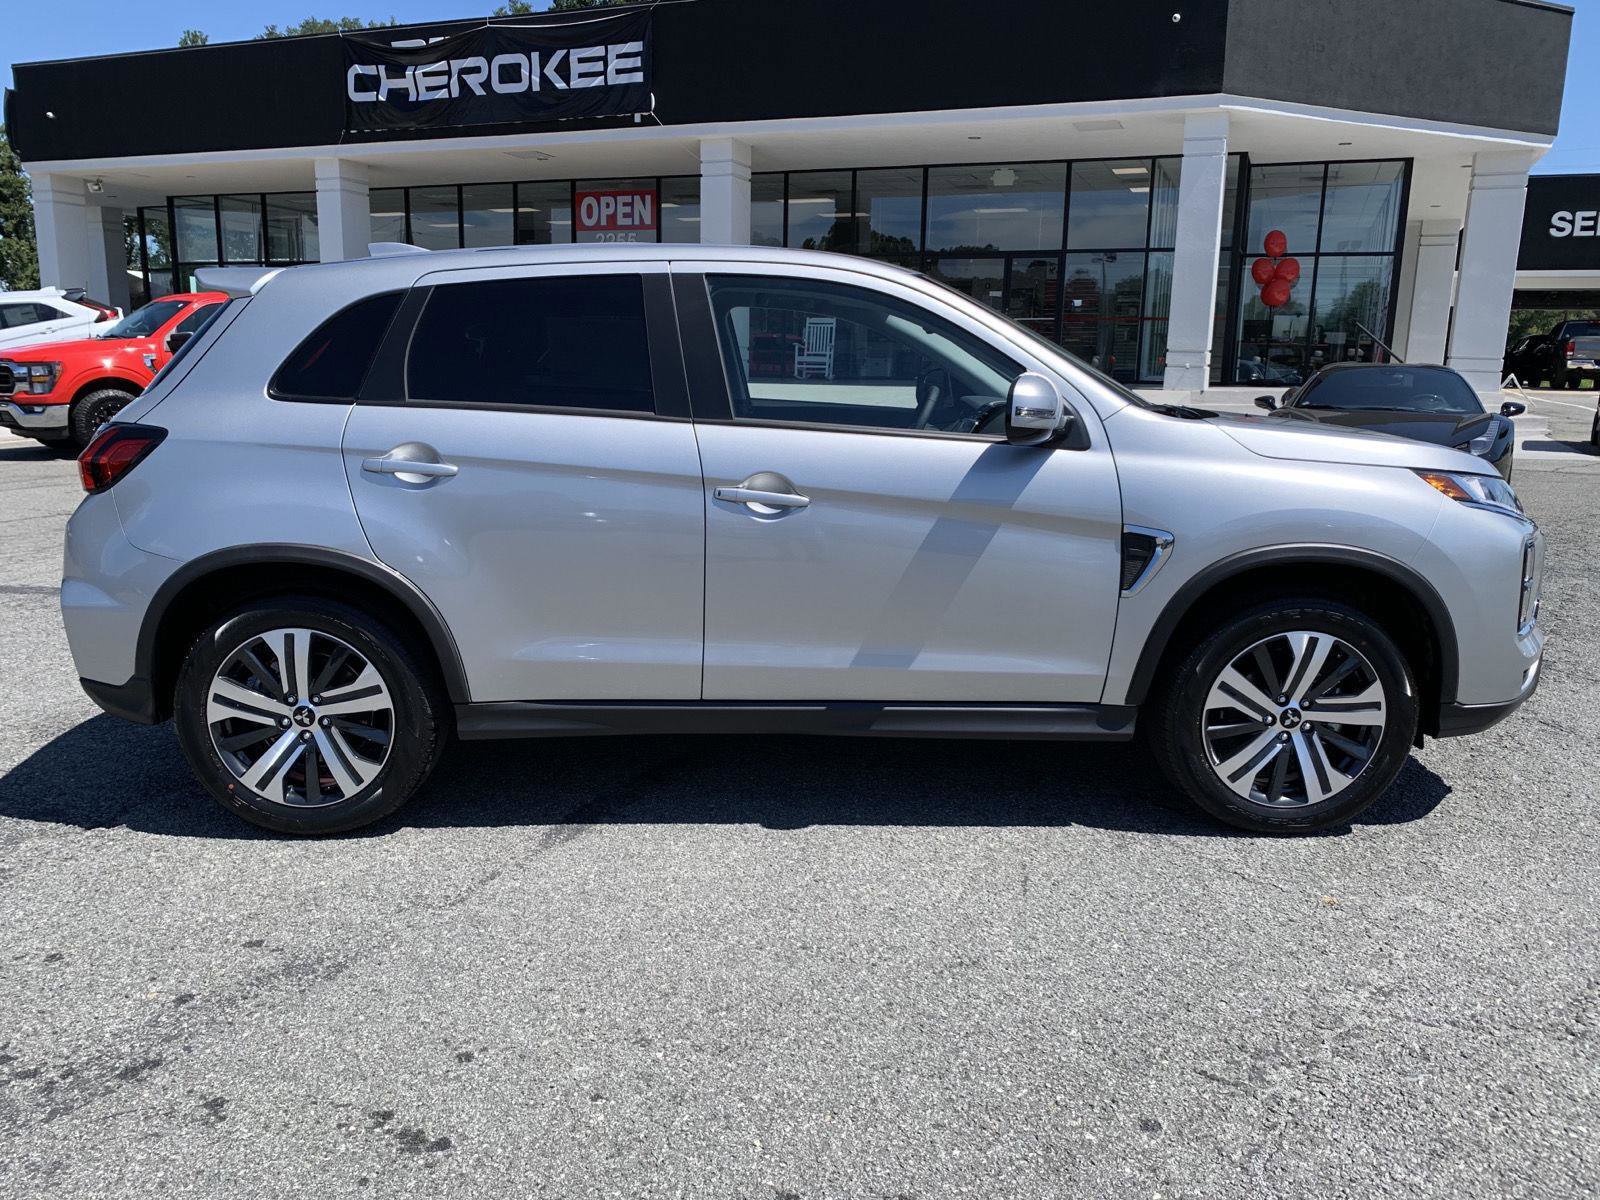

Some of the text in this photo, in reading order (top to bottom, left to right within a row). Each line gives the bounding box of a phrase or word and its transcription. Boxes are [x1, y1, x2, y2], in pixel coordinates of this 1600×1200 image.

[347, 41, 644, 102] CHEROKEE
[580, 194, 652, 227] OPEN
[1549, 210, 1600, 238] SE
